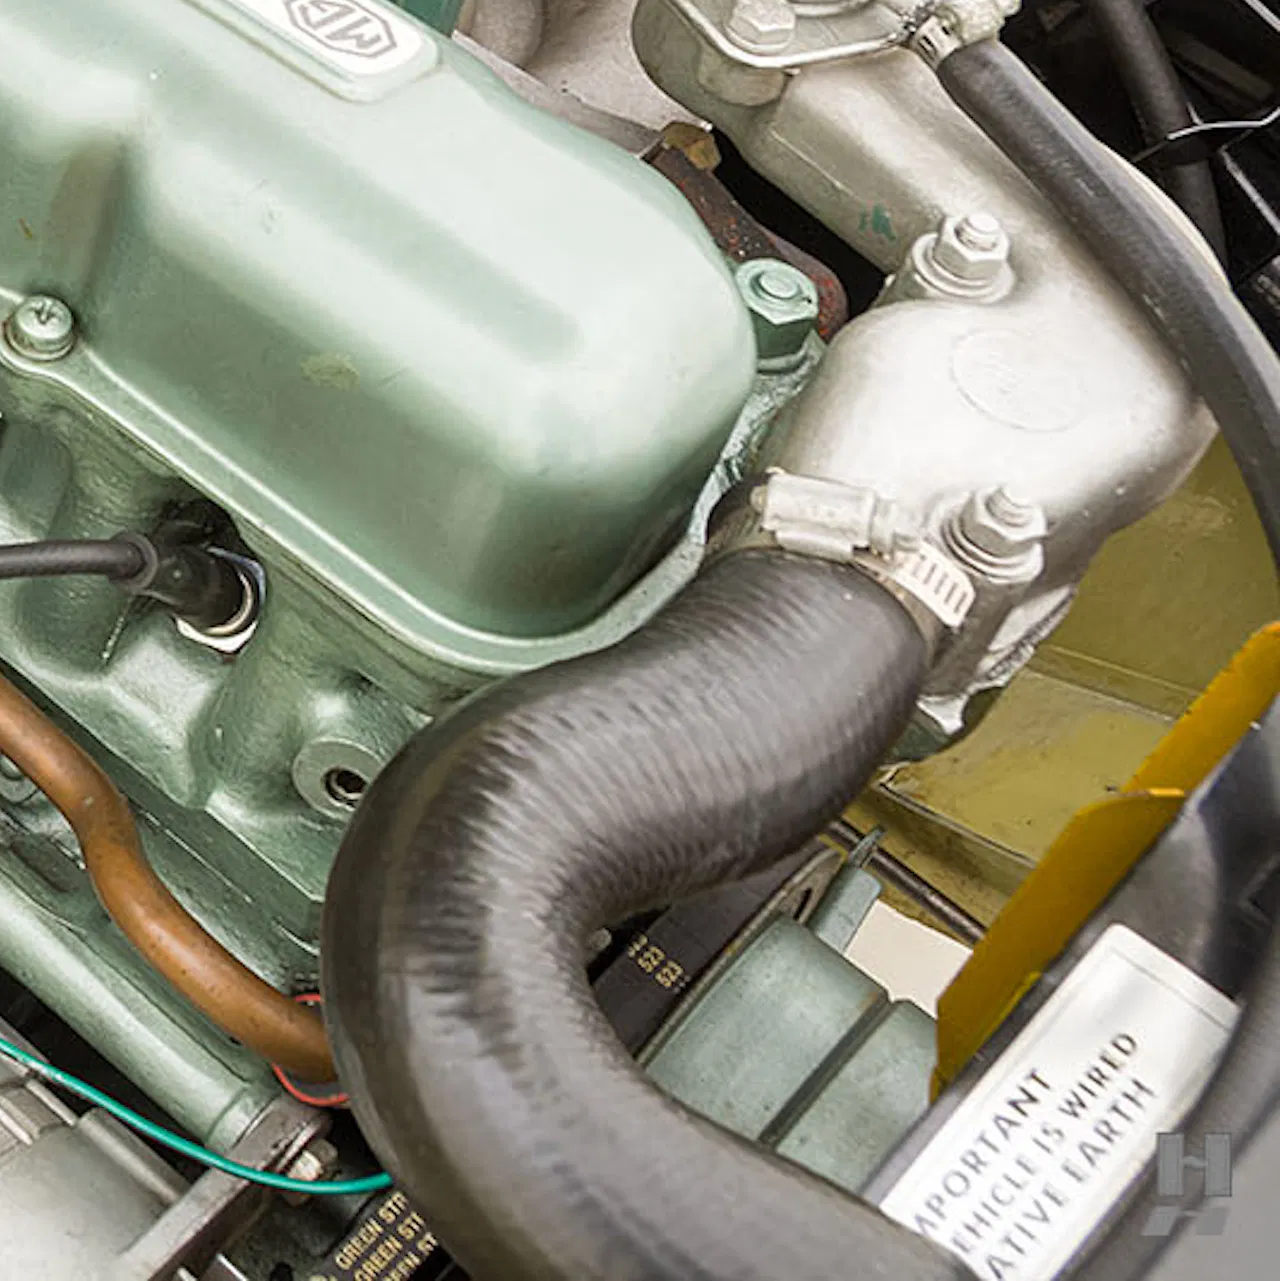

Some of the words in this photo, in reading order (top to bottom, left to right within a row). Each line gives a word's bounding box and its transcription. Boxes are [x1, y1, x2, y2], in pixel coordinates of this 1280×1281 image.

[376, 1190, 410, 1224] STR
[948, 1154, 1040, 1256] EHICLE
[1031, 1121, 1067, 1155] IS
[1057, 1030, 1140, 1121] WIRED
[984, 1183, 1069, 1281] ATIVE
[1062, 1076, 1159, 1184] EARTH
